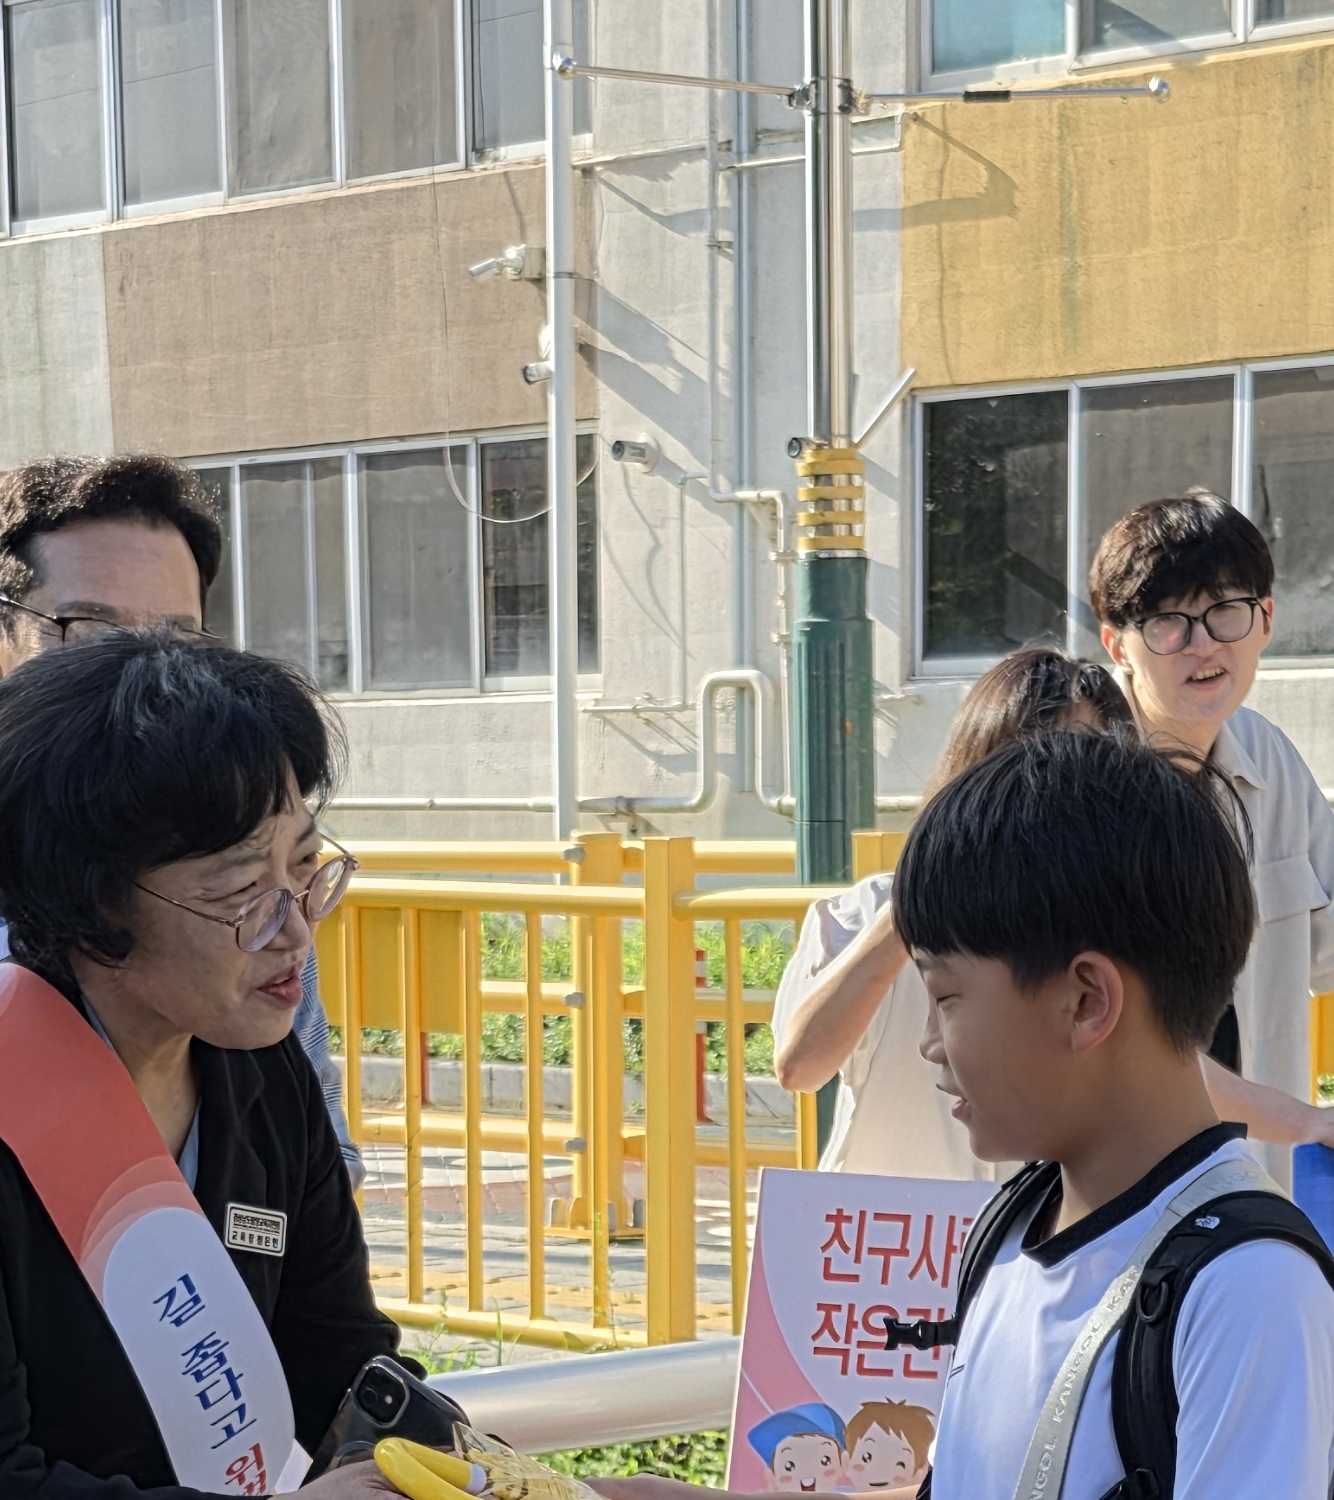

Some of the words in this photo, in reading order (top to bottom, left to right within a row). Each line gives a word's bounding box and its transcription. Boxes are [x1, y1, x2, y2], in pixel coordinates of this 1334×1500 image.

[820, 1208, 974, 1289] 친구사
[153, 1273, 206, 1328] 길
[181, 1331, 257, 1450] 좁다고
[1052, 1320, 1103, 1424] KANGOL
